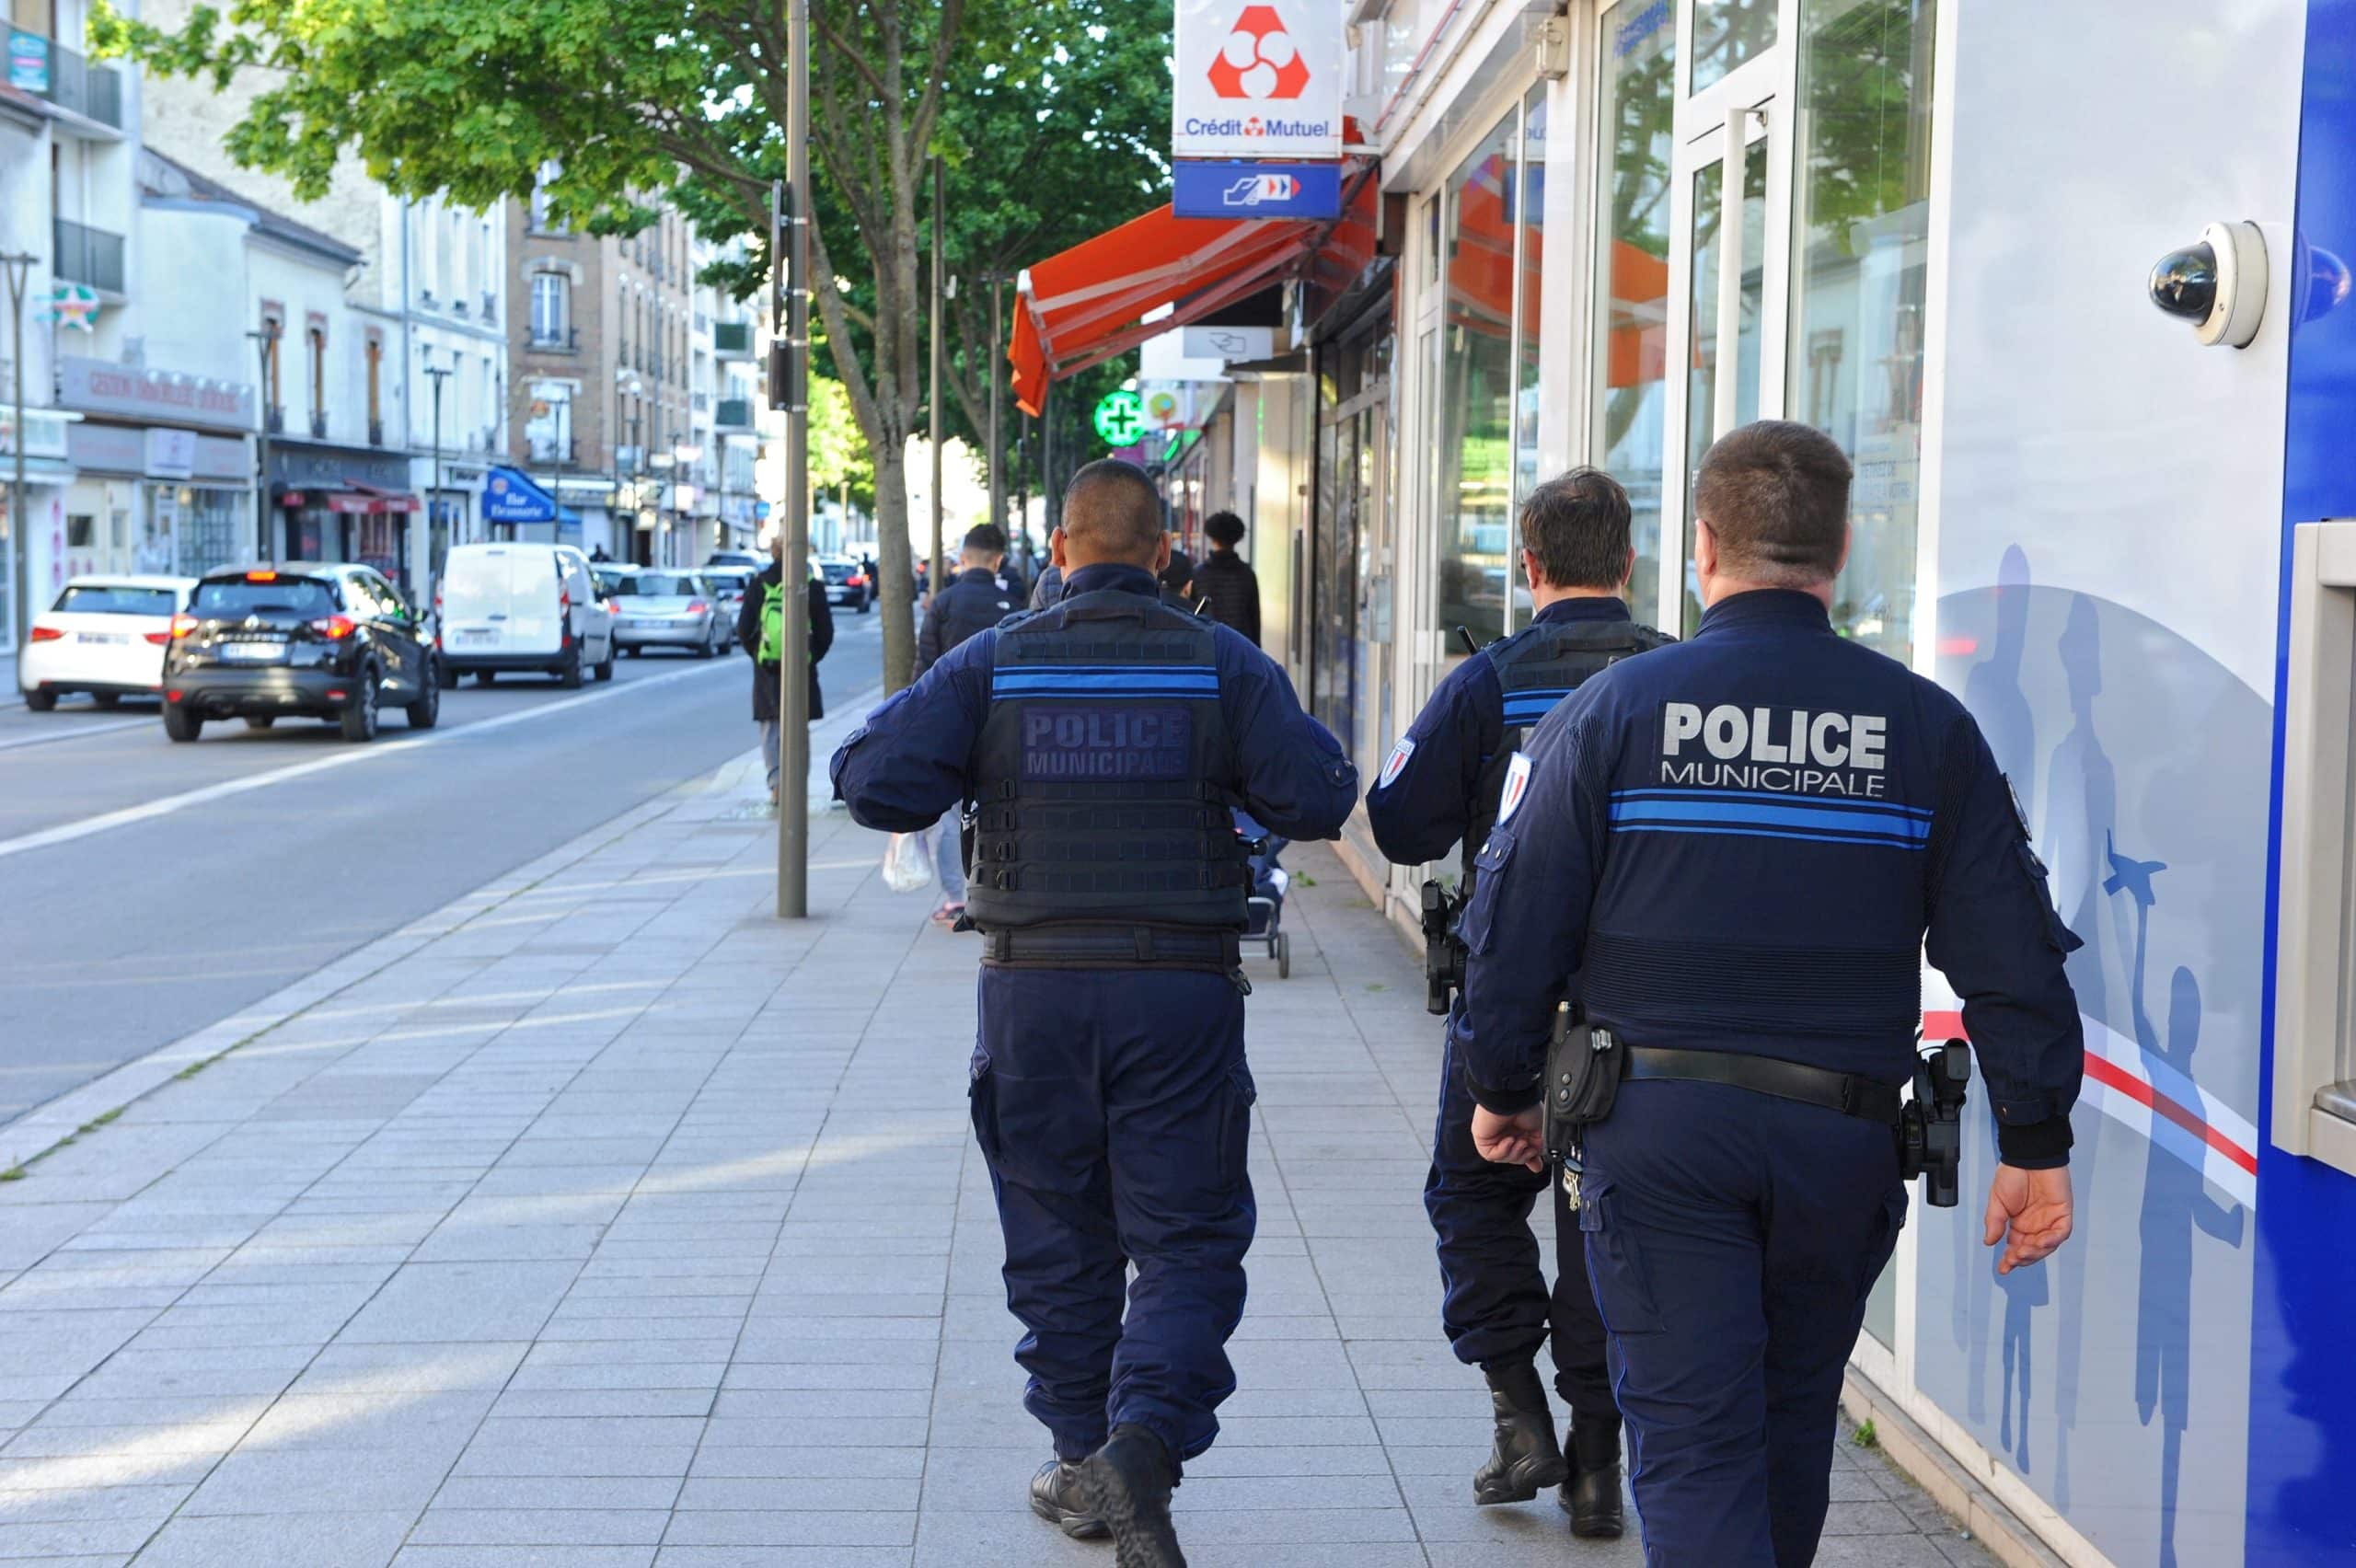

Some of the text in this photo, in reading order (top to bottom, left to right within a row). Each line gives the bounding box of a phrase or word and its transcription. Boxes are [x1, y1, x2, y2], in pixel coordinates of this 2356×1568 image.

[1185, 118, 1329, 137] Crédit Mutuel
[1025, 713, 1184, 748] POLICE
[1663, 702, 1886, 769] POLICE
[1027, 751, 1185, 775] MUNICIPALE
[1661, 761, 1886, 798] MUNICIPALE
